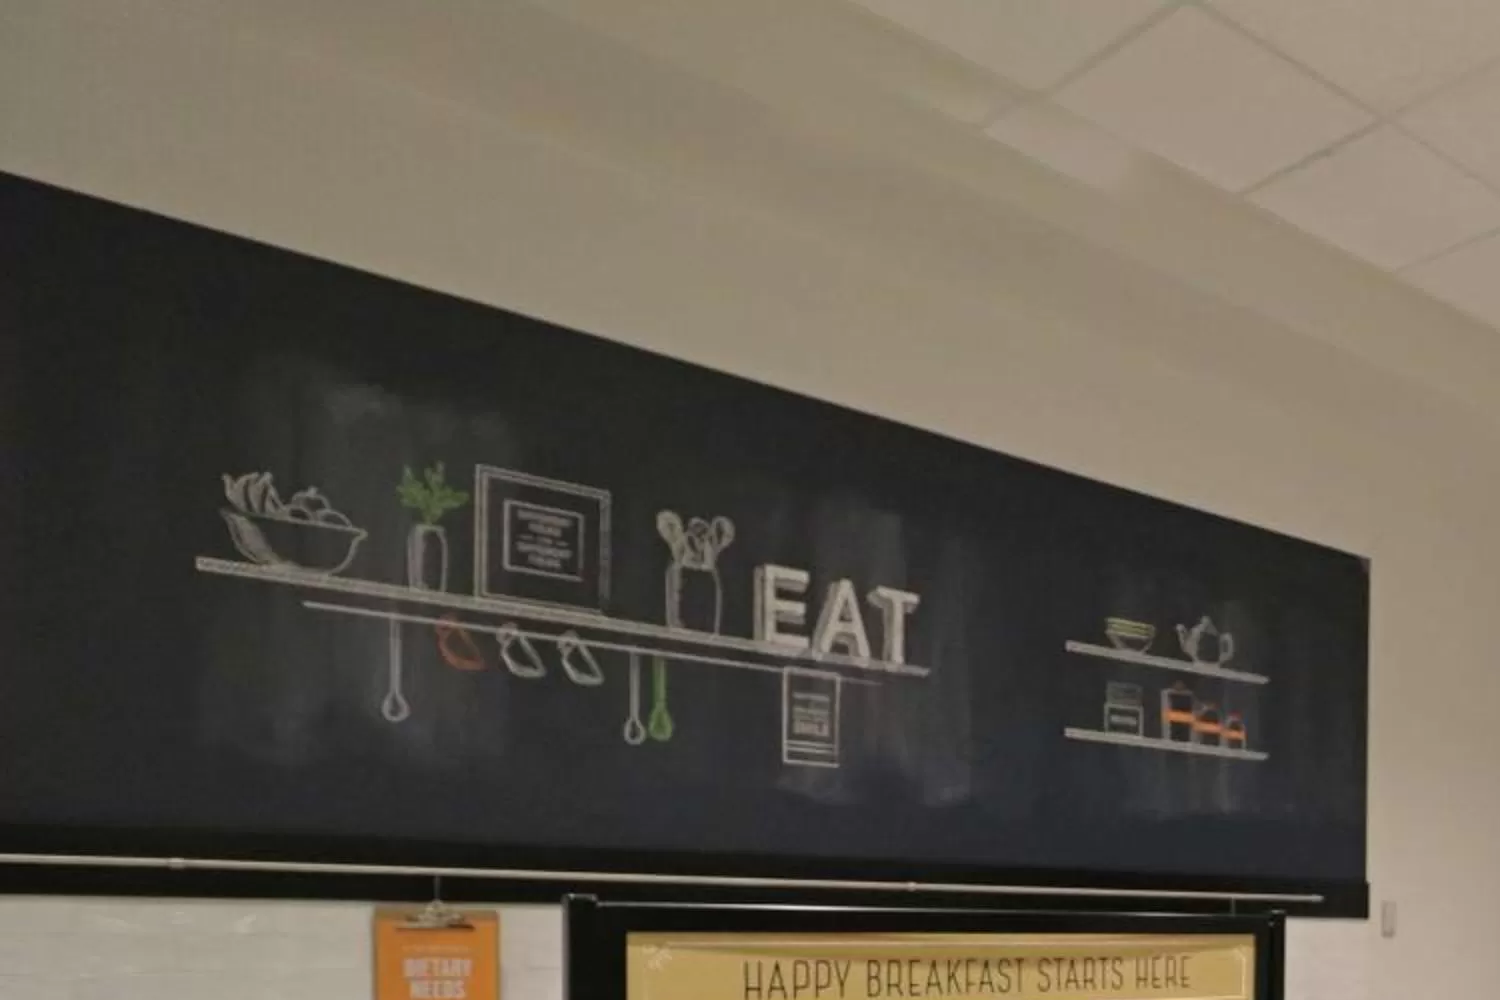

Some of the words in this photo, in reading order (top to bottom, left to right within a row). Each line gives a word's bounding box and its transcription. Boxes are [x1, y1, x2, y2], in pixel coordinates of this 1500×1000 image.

[754, 563, 921, 667] EAT
[744, 959, 852, 1000] HAPPY
[867, 957, 1025, 998] BREAKFAST
[1037, 956, 1124, 993] STARTS
[1135, 955, 1193, 990] HERE
